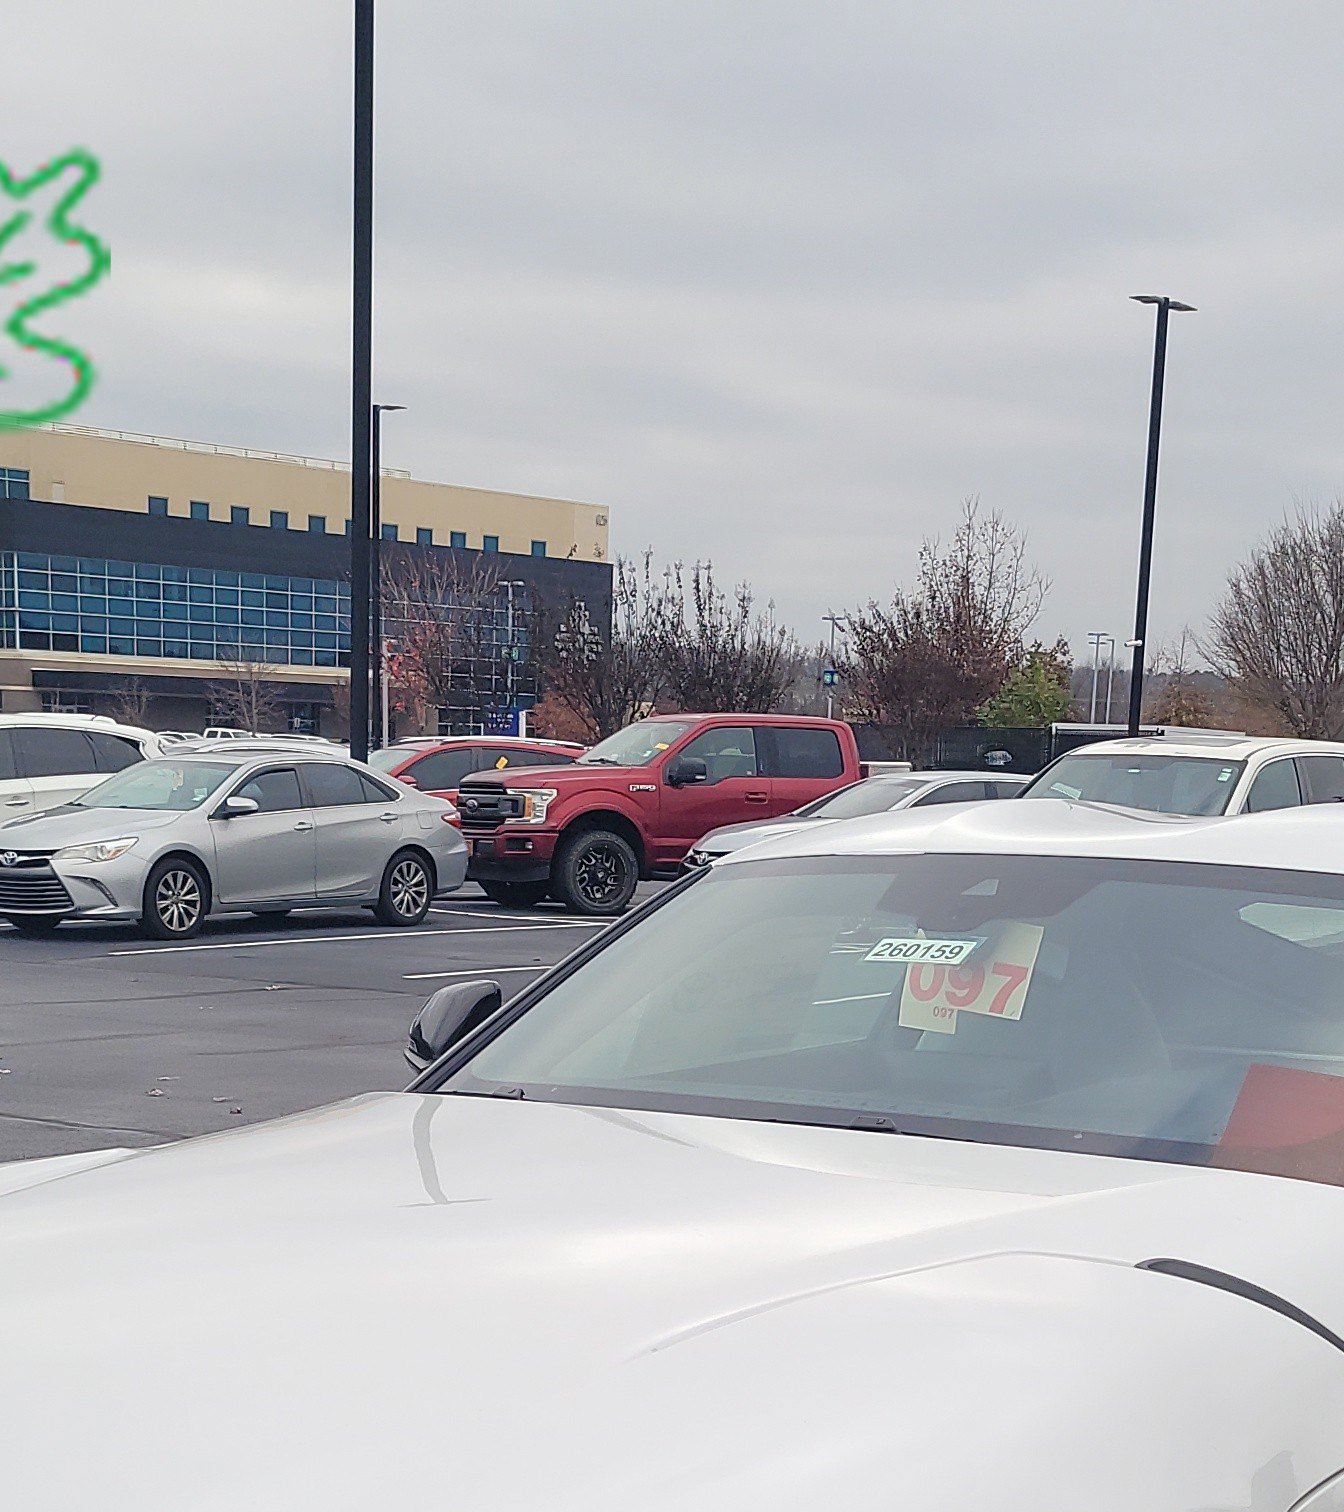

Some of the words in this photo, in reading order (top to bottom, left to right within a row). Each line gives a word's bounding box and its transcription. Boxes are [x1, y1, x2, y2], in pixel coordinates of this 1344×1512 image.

[872, 942, 965, 960] 260159
[909, 962, 1029, 1015] 097
[933, 1006, 955, 1020] 097
